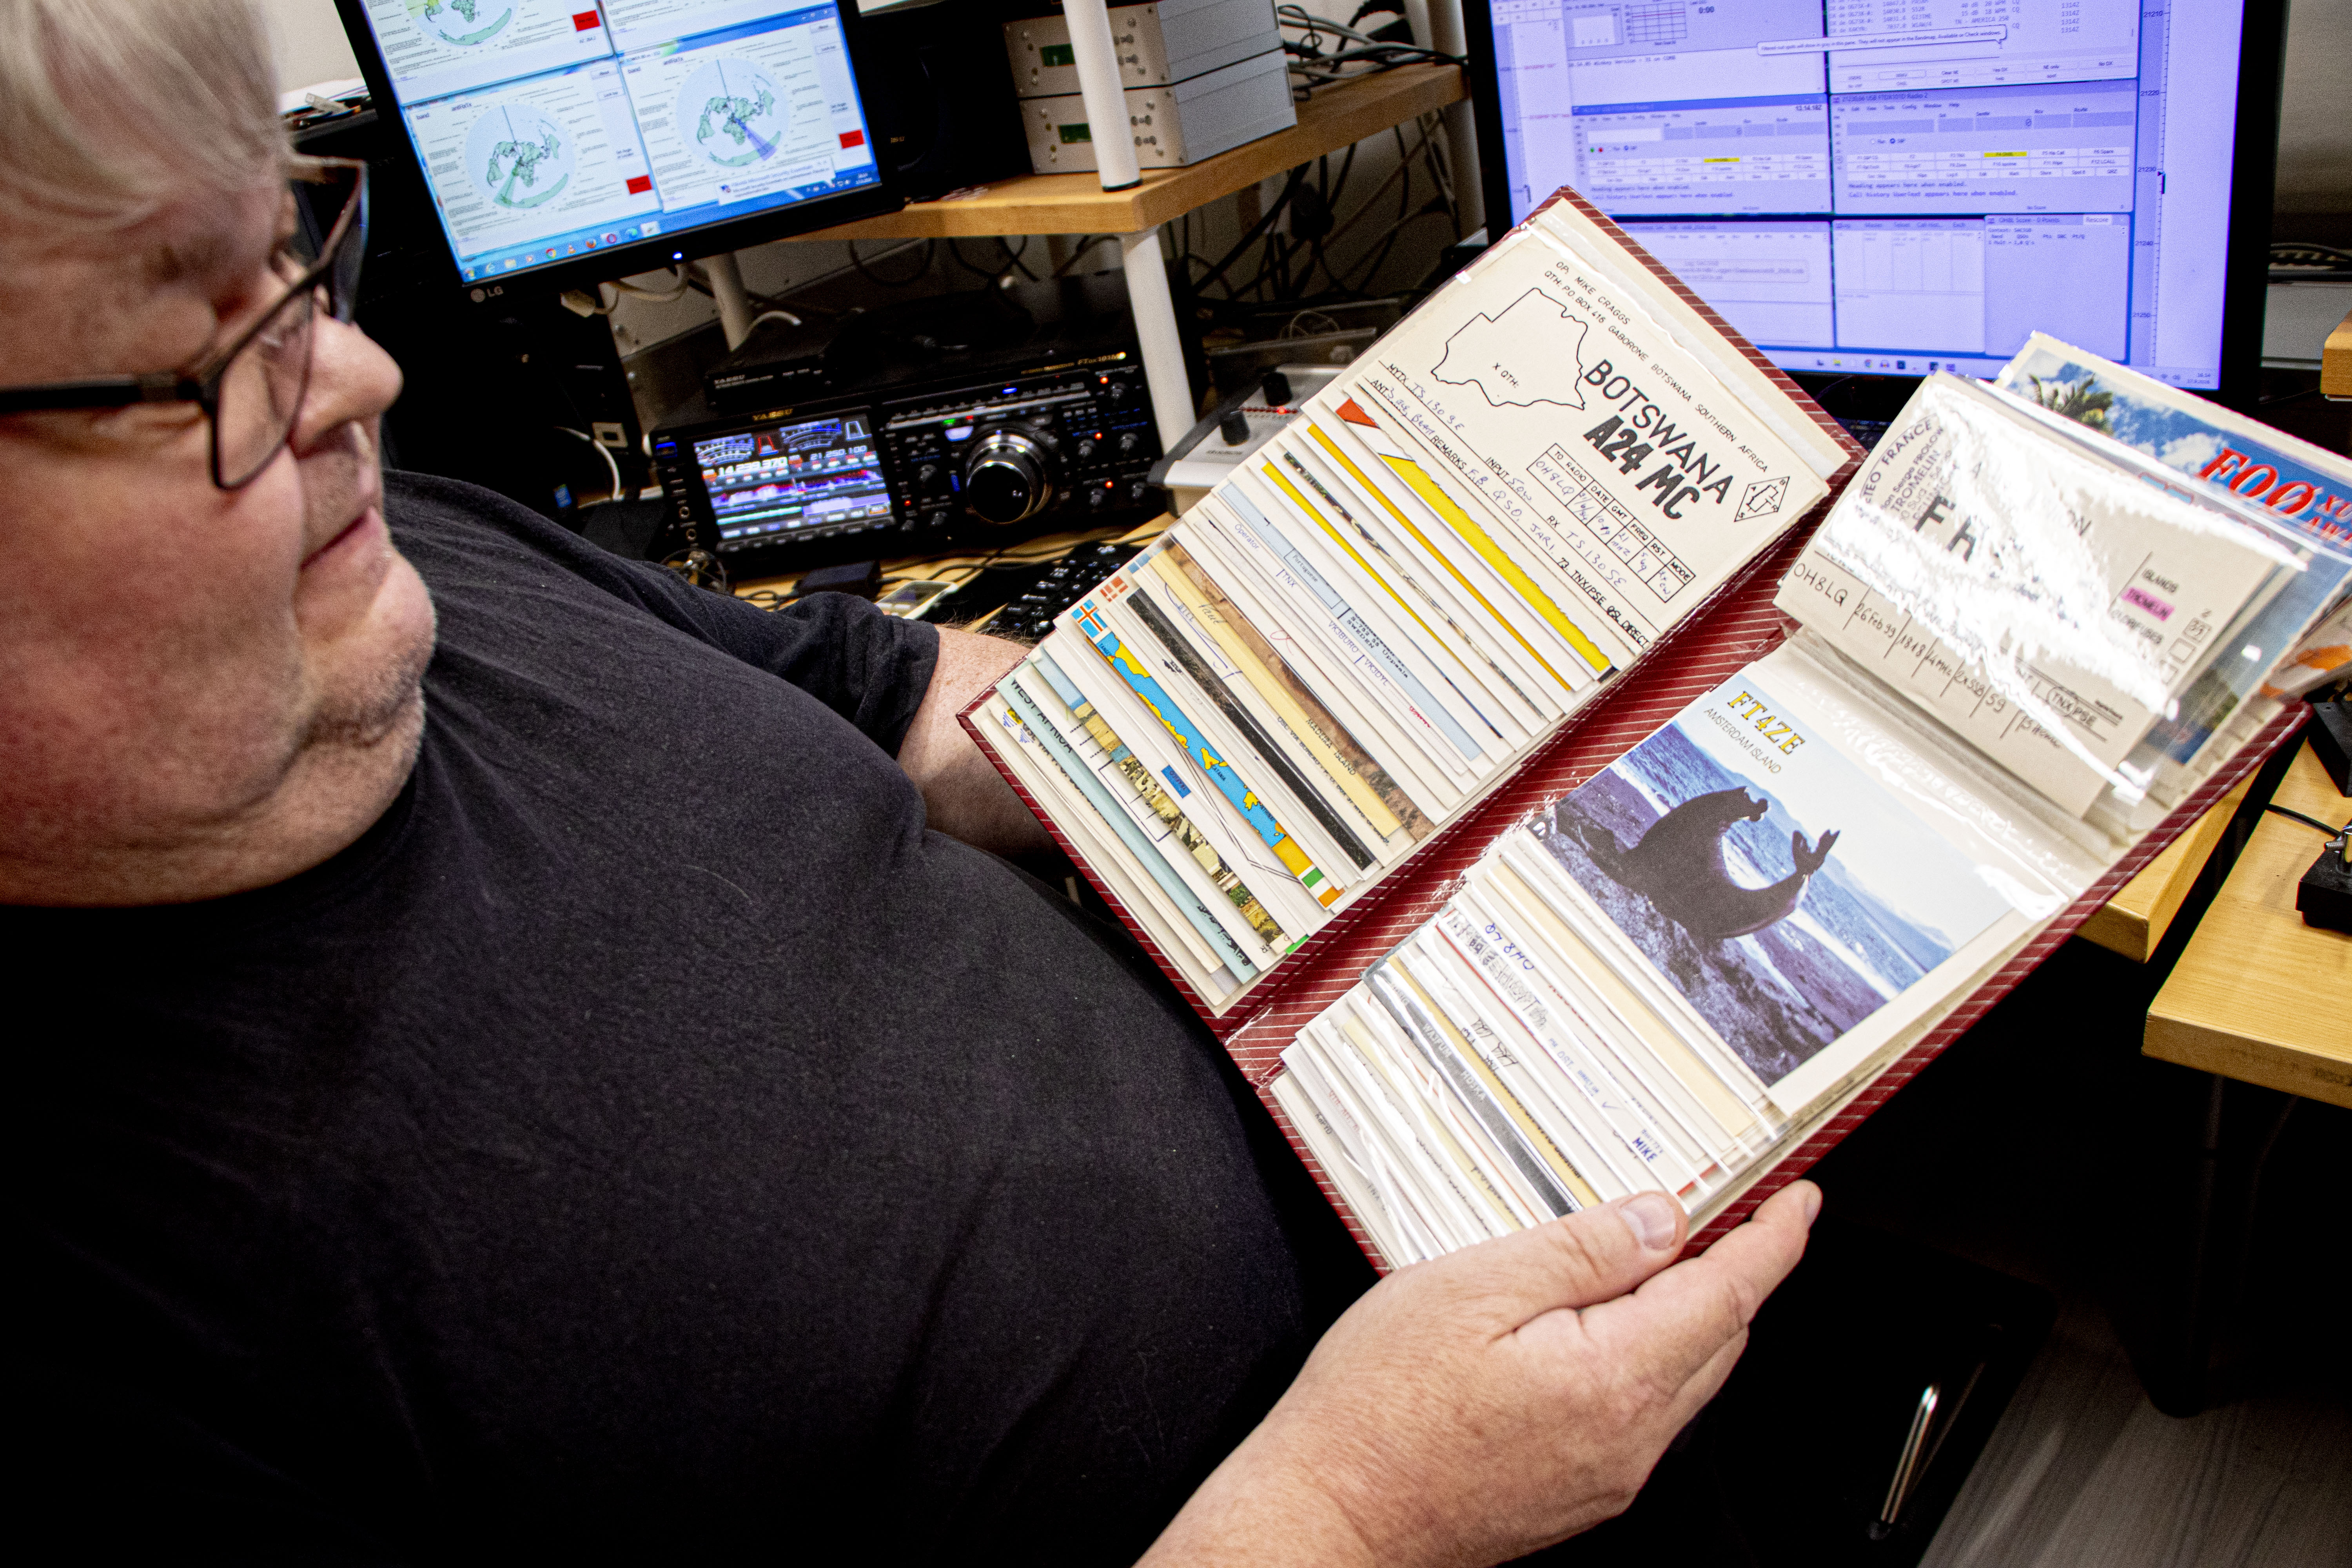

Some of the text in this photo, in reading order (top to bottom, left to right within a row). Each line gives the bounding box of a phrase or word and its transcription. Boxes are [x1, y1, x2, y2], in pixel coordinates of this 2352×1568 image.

[486, 286, 503, 297] LG
[1575, 277, 1630, 325] MIKE CRAGGS
[1501, 370, 1519, 388] QTH:
[1544, 270, 1562, 287] QTH:
[1575, 296, 1592, 311] BOX
[1592, 311, 1606, 323] 416
[1608, 325, 1649, 361] GABORONE
[1651, 364, 1691, 402] BOTSWANA
[1695, 404, 1737, 442] SOUTHERN
[1738, 445, 1768, 472] AFRICA
[1584, 359, 1733, 504] BOTSWANA
[1882, 419, 1932, 465] FRANCE
[1430, 435, 1467, 470] REMARKS
[1485, 457, 1510, 479] INPUT
[1536, 461, 1575, 496] OH8LQ
[1635, 463, 1700, 519] MC
[1890, 449, 1940, 512] TROMELIN
[1893, 467, 1915, 493] Serge
[1546, 515, 1560, 528] RX
[1554, 451, 1691, 581] TO RADIO DATE GMT FREQ RST MODE
[1234, 524, 1259, 549] Operator
[1283, 572, 1298, 588] TNX
[1292, 554, 1318, 583] Portuguese
[1794, 563, 1848, 607] OH8LQ
[1328, 621, 1359, 653] VK3BURO
[1346, 619, 1375, 649] SWEDEN
[1621, 620, 1650, 648] DIRECT
[1382, 649, 1409, 679] Uppsala
[1727, 691, 1806, 755] FT4ZE
[2049, 692, 2098, 728] TNX PSE
[1306, 719, 1357, 776] MADEIRA ISLAND
[1704, 708, 1781, 774] AMSTERDAM ISLAND
[1632, 1137, 1658, 1163] MIKE
